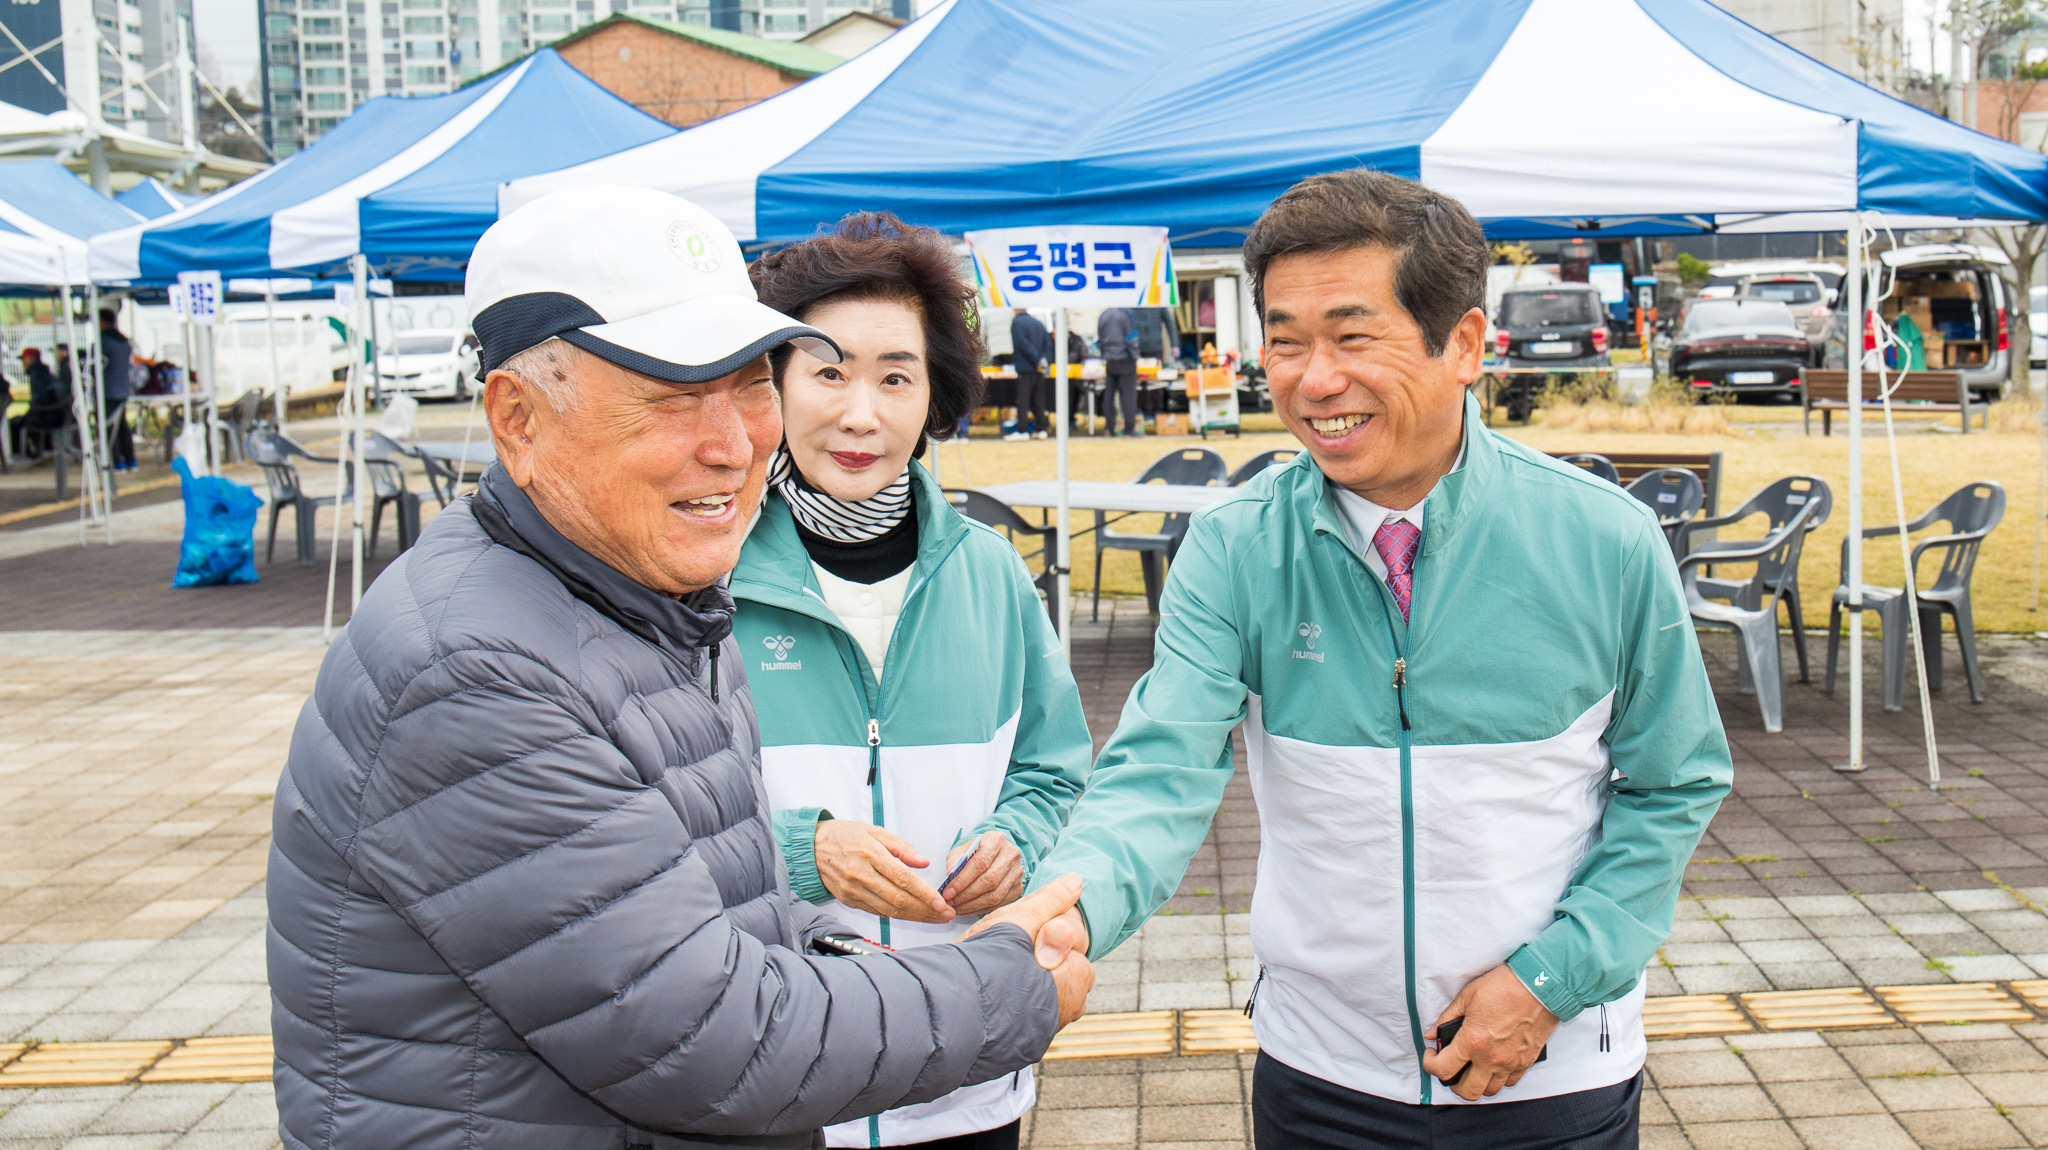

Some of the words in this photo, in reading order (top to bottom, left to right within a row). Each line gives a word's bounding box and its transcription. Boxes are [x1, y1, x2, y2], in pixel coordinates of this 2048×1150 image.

[1008, 242, 1136, 292] 증평군
[1292, 649, 1325, 663] hummel
[761, 660, 802, 671] hummel
